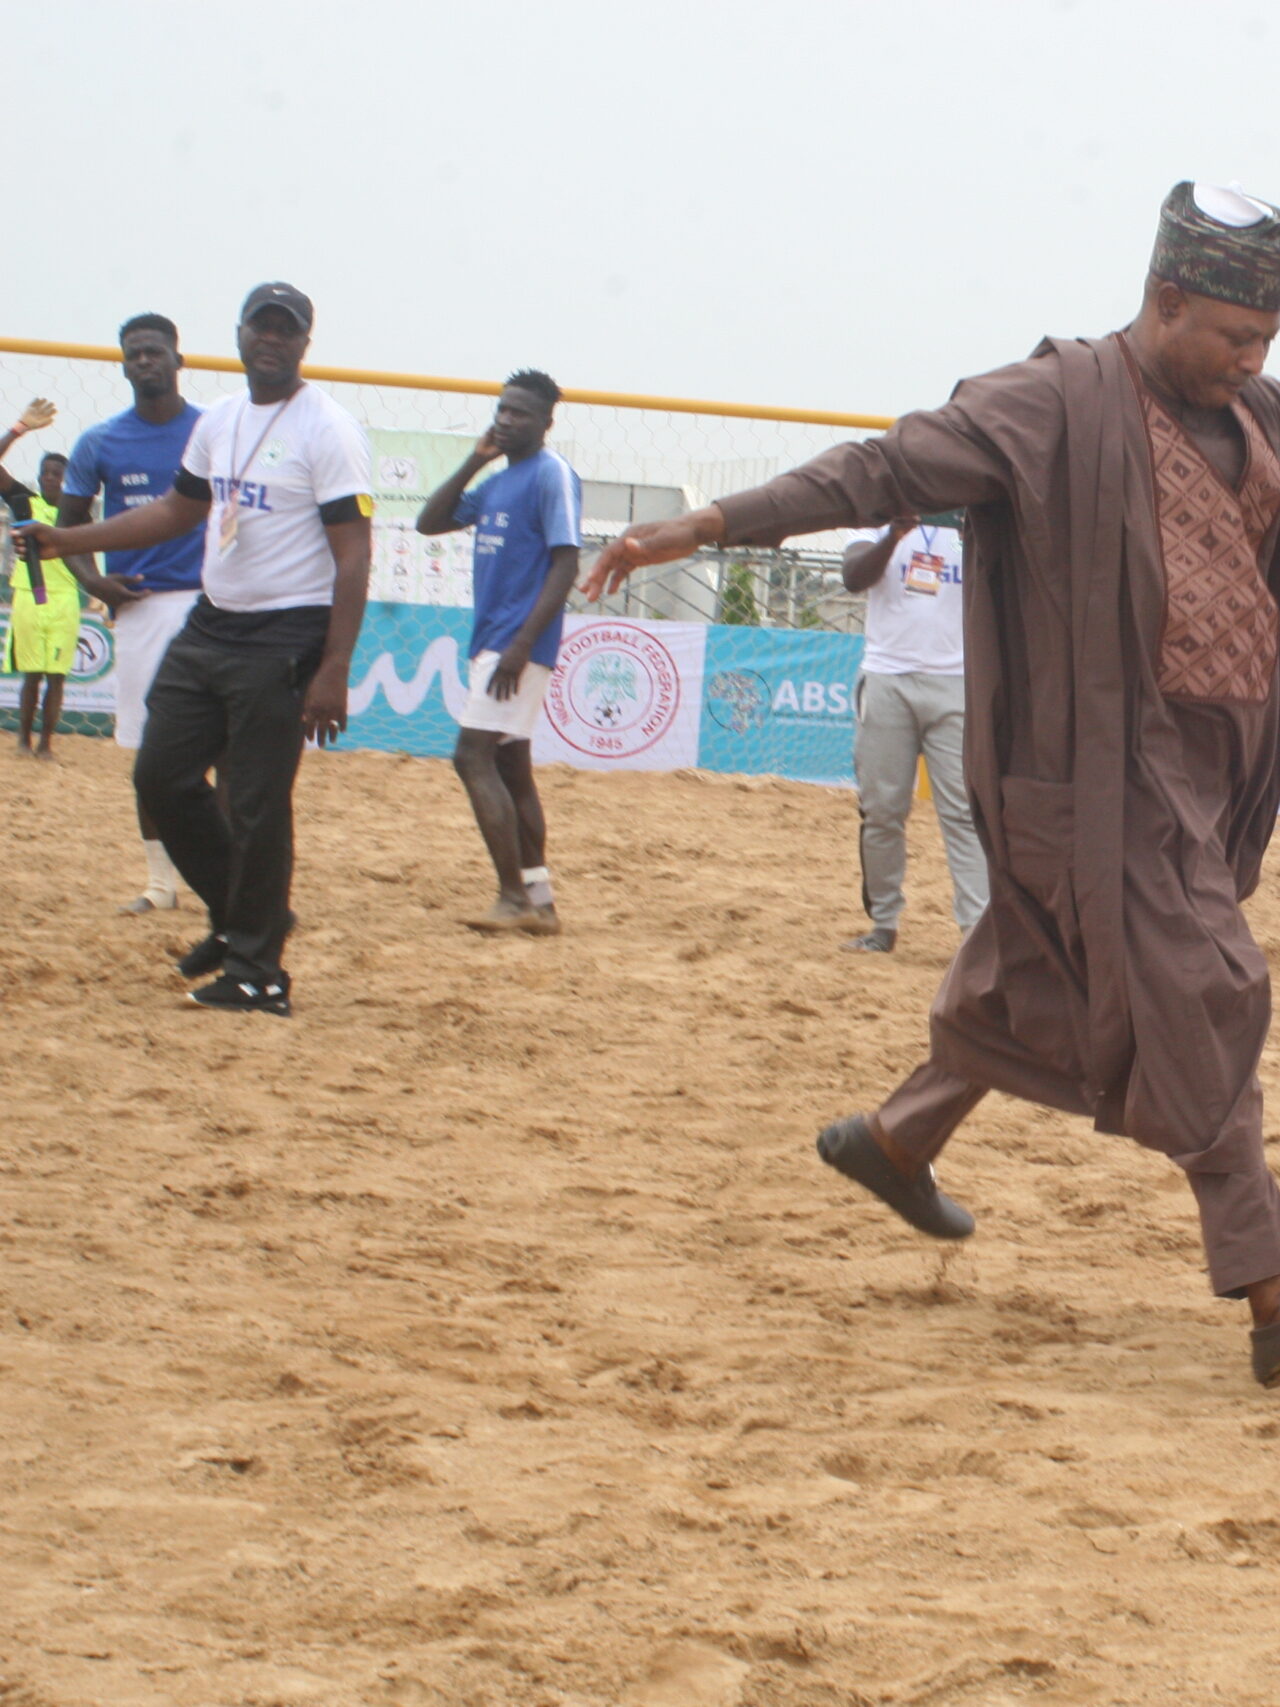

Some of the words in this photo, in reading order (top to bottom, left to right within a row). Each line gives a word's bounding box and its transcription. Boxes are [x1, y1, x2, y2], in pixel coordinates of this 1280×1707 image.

[550, 663, 572, 727] NIGERIA
[561, 631, 640, 663] FOOTBALL
[641, 644, 673, 737] FEDERATION
[772, 679, 858, 714] ABS
[589, 735, 624, 750] 1945
